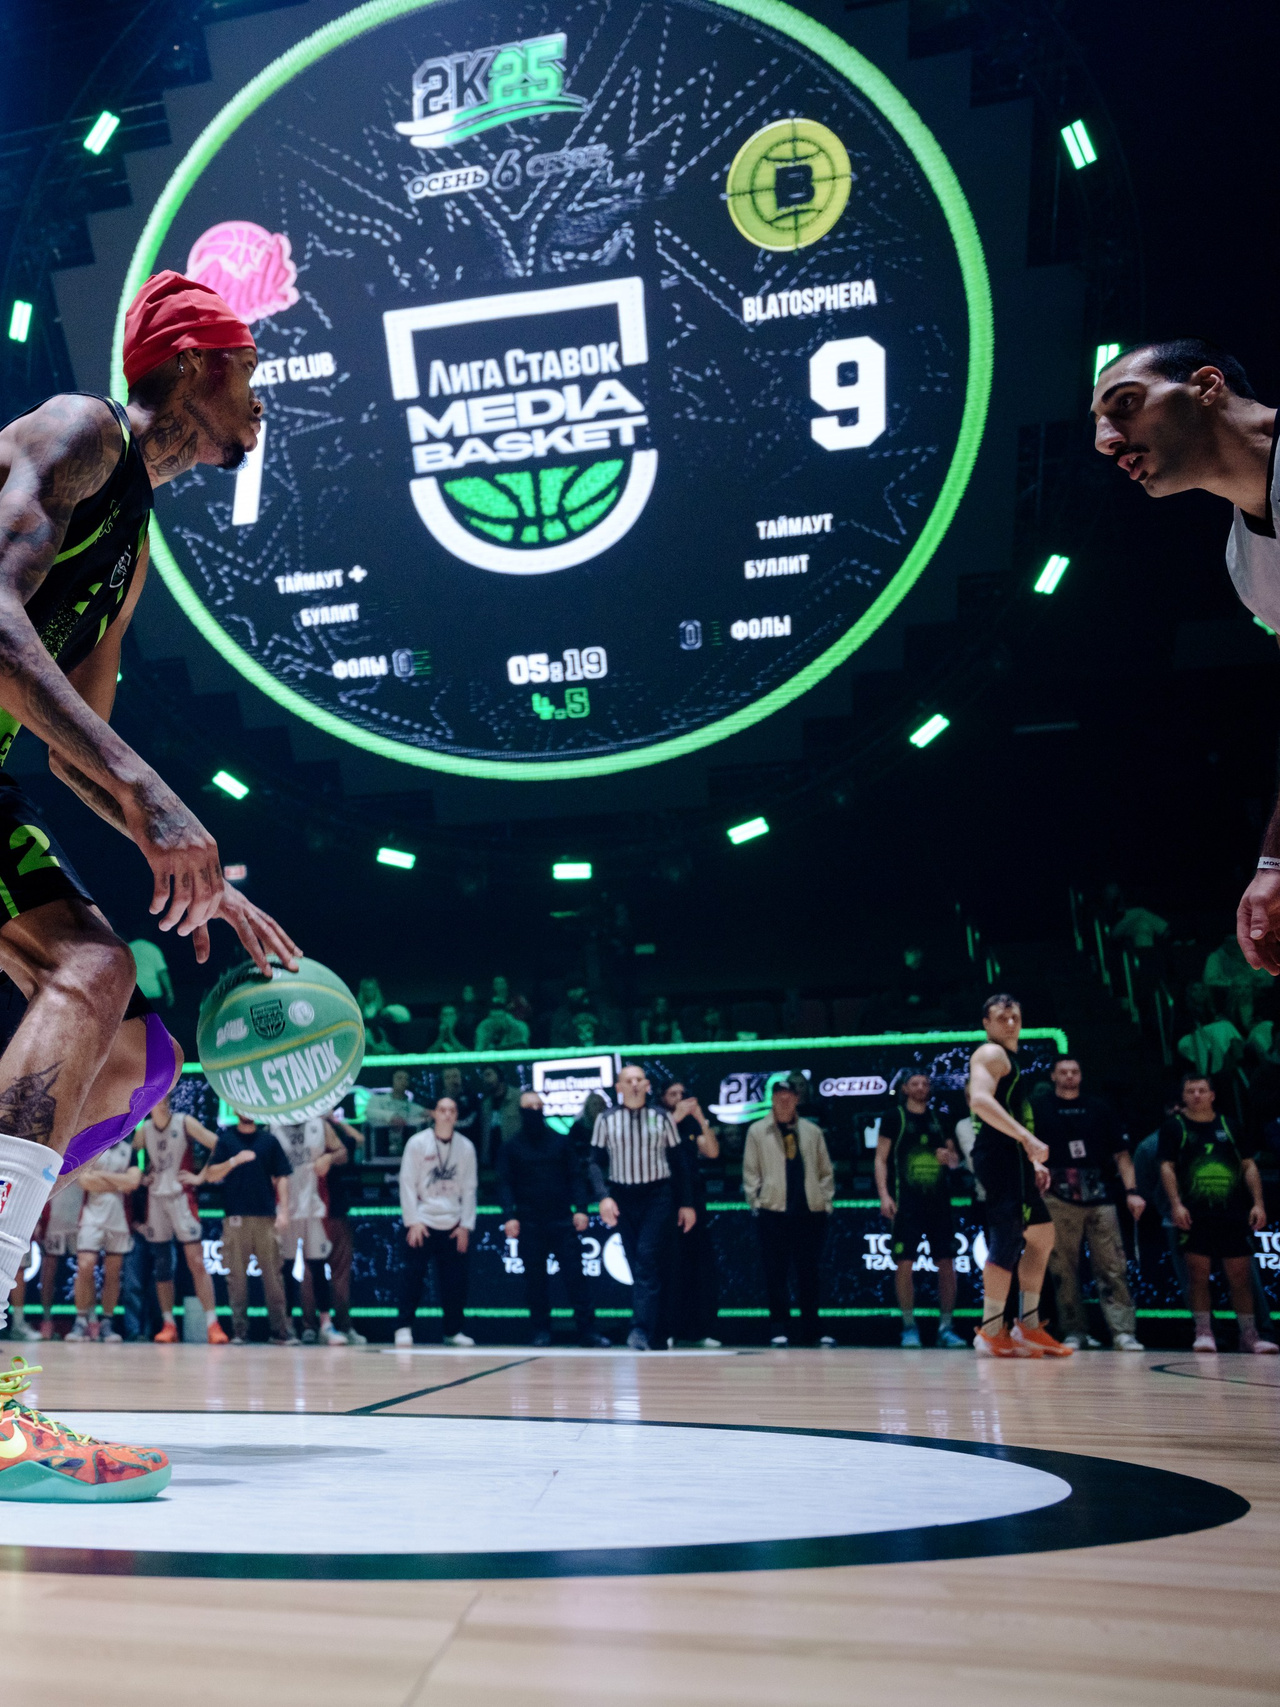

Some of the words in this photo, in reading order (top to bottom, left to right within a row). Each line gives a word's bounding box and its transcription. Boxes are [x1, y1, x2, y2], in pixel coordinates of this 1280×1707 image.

[412, 32, 567, 121] 2K25
[410, 168, 487, 197] ОСЕНЬ
[742, 279, 877, 323] BLATOSPHERA
[288, 351, 337, 381] CLUB
[809, 336, 885, 451] 9
[406, 379, 646, 444] MEDIA
[412, 415, 650, 474] BASKET
[756, 513, 833, 540] ТАЙМАУТ
[275, 568, 344, 594] ТАЙМАУТ
[744, 554, 810, 580] БУЛЛИТ
[300, 602, 360, 627] БУЛЛИТ
[730, 615, 792, 641] ФОЛЫ
[332, 655, 389, 679] ФОЛЫ
[507, 646, 608, 685] 05:19
[531, 687, 590, 720] 4.5
[9, 825, 61, 876] 2
[220, 1066, 268, 1108] LIGA
[262, 1039, 342, 1105] STAVOK
[820, 1077, 887, 1097] ОСЕНЬ
